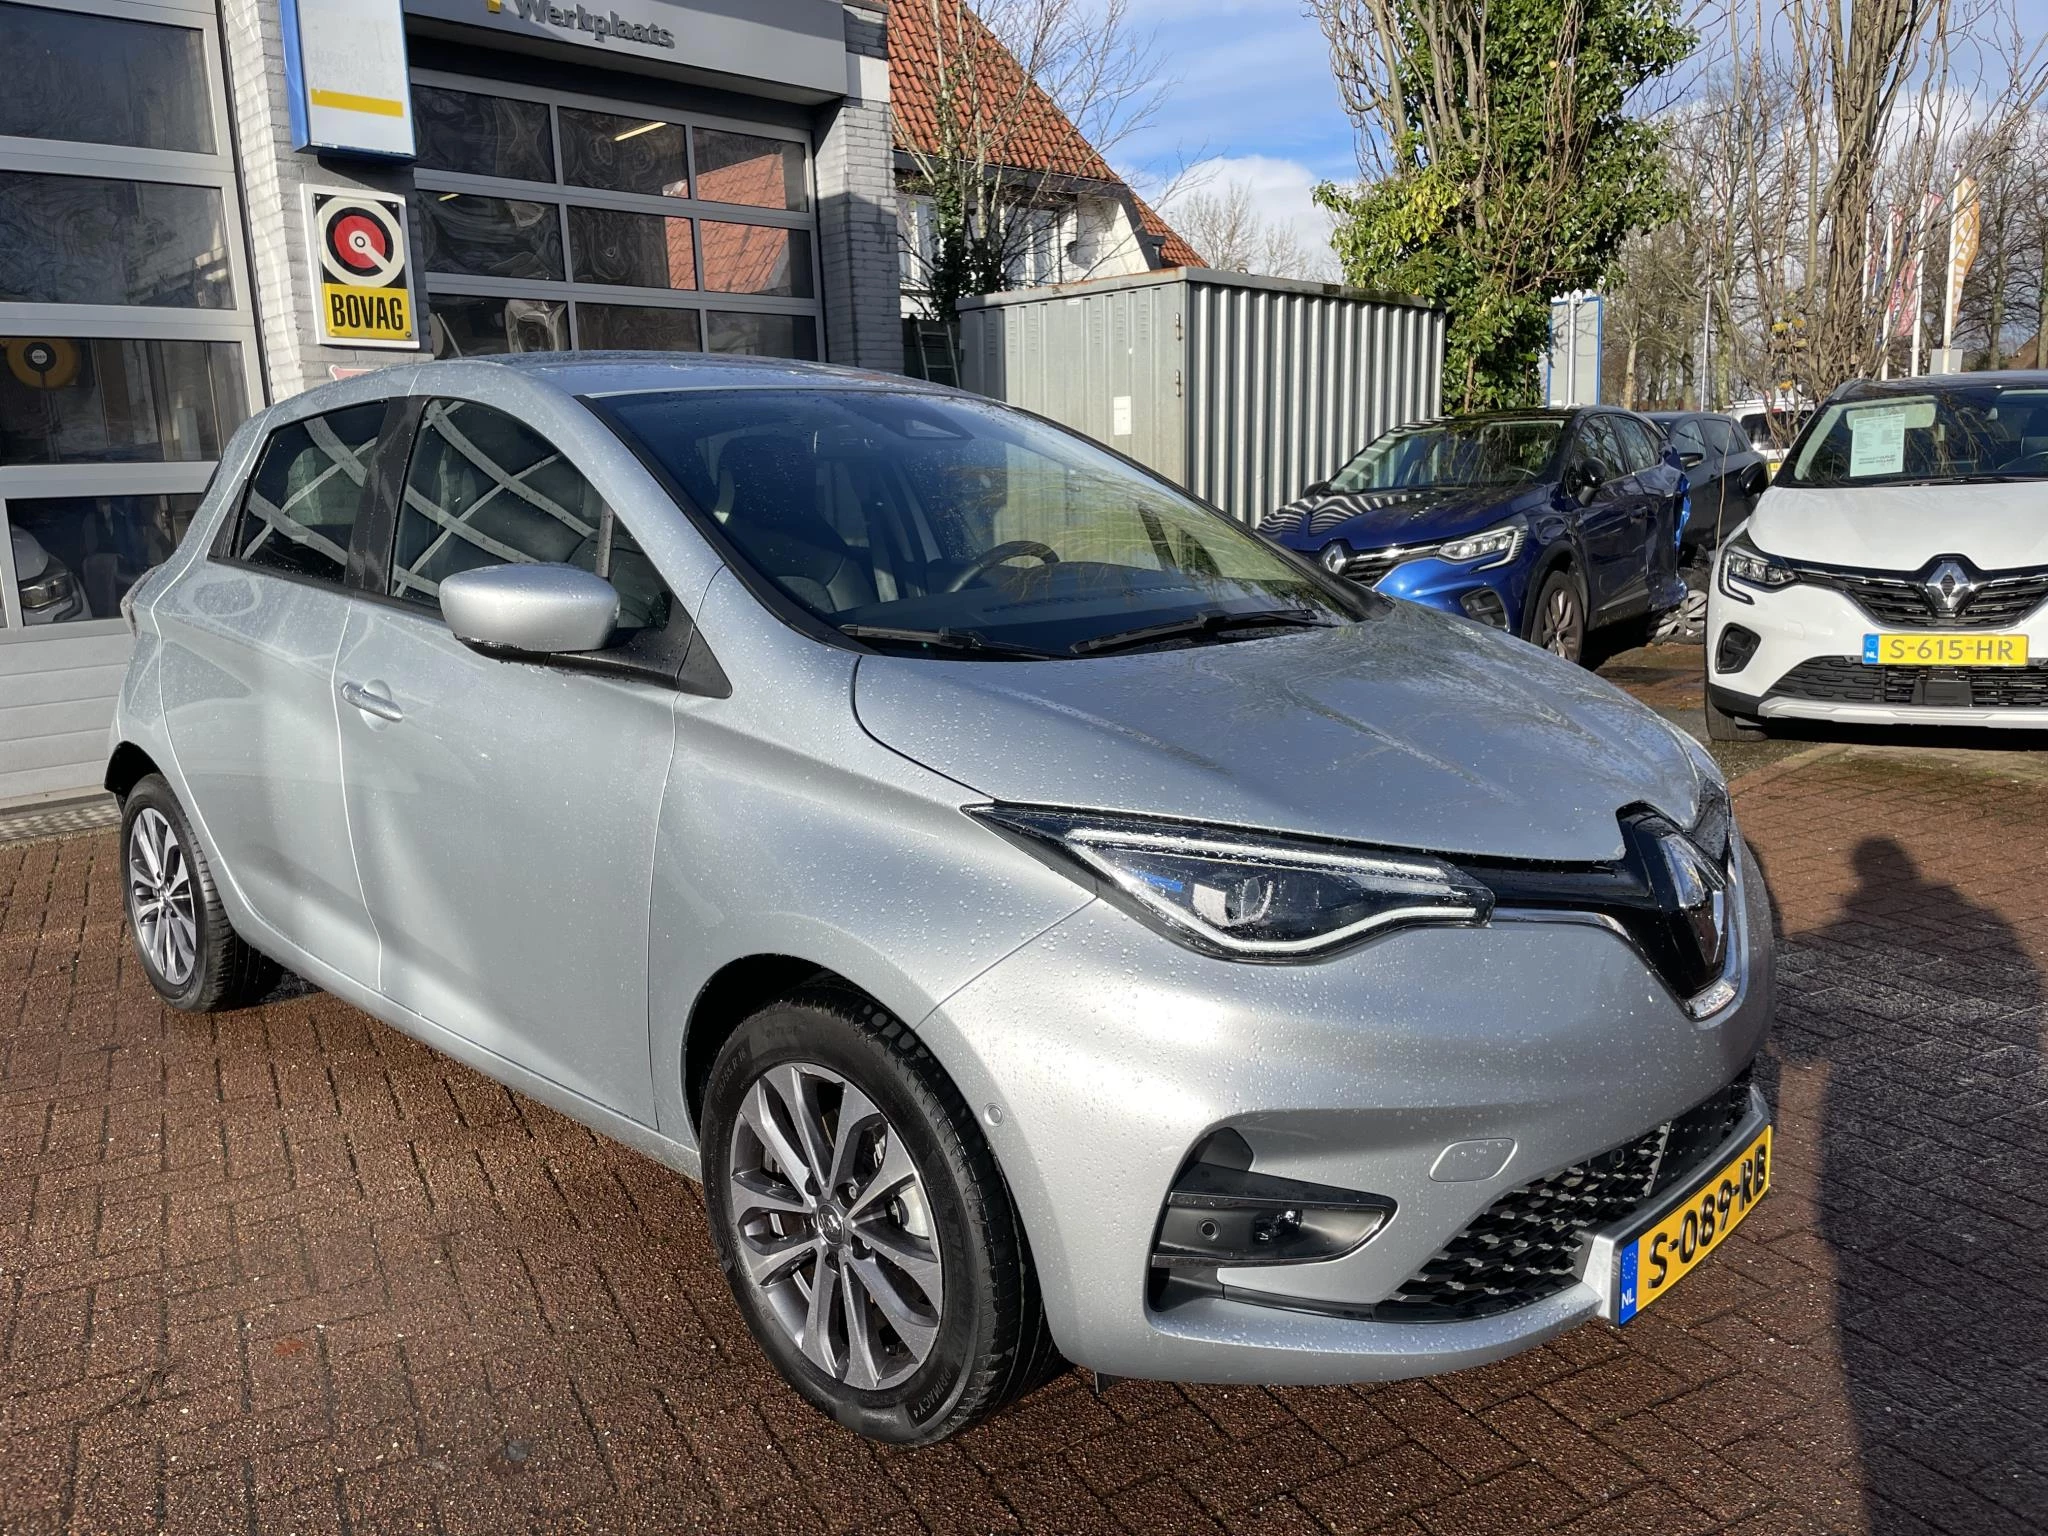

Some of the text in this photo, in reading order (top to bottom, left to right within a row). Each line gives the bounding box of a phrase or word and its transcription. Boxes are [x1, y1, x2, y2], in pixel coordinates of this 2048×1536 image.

[514, 0, 675, 49] Werkplaats
[330, 293, 404, 331] BOVAG
[1889, 639, 2014, 660] S-615-HR
[1647, 1144, 1767, 1289] S-089-RB
[1621, 1288, 1635, 1309] NL
[918, 1366, 952, 1415] PRIMACY
